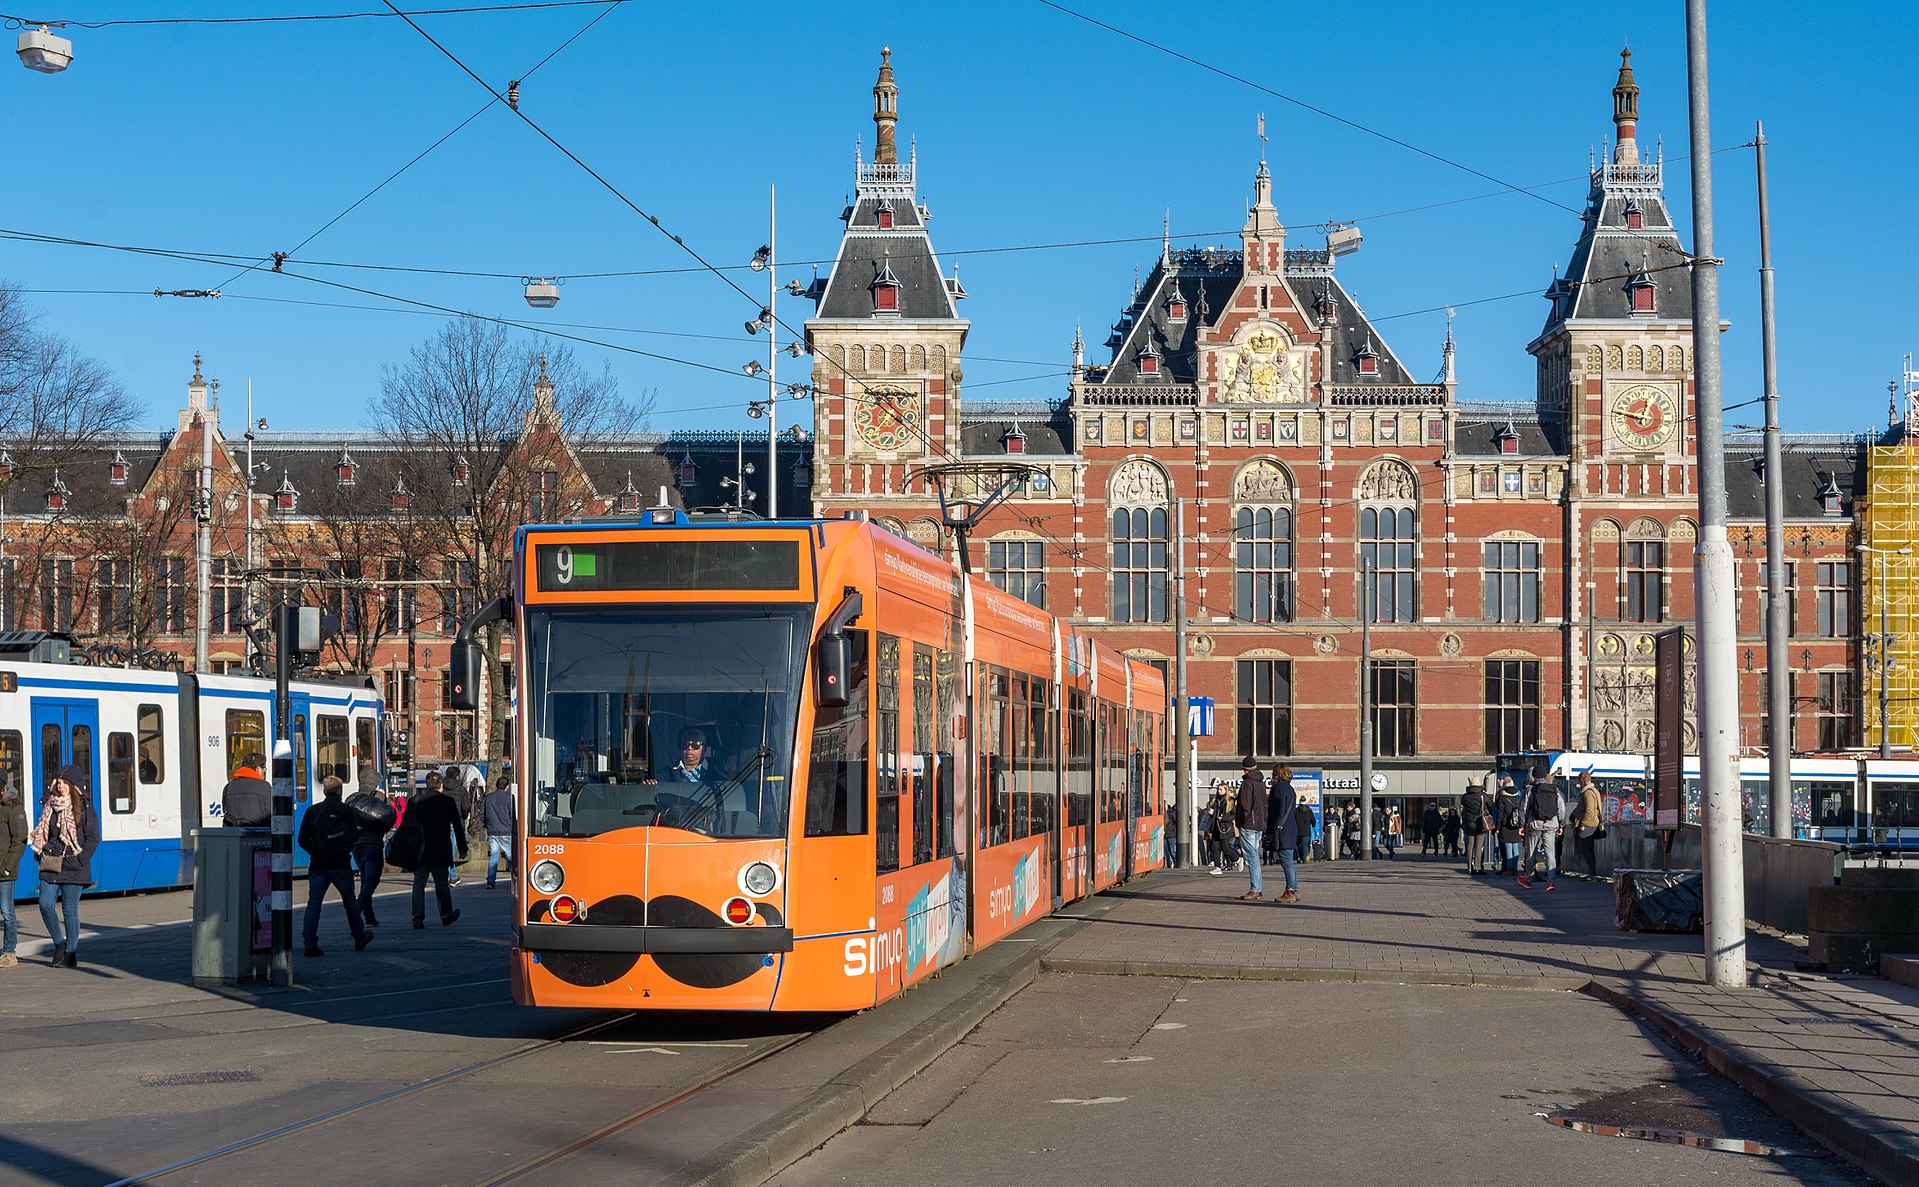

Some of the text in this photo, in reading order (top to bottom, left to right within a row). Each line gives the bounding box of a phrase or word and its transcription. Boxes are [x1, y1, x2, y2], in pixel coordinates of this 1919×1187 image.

[557, 545, 573, 584] 9
[207, 735, 220, 747] 906
[534, 844, 564, 855] 2088
[881, 884, 894, 905] 2088
[989, 876, 1012, 928] simyo
[843, 916, 903, 986] simyo
